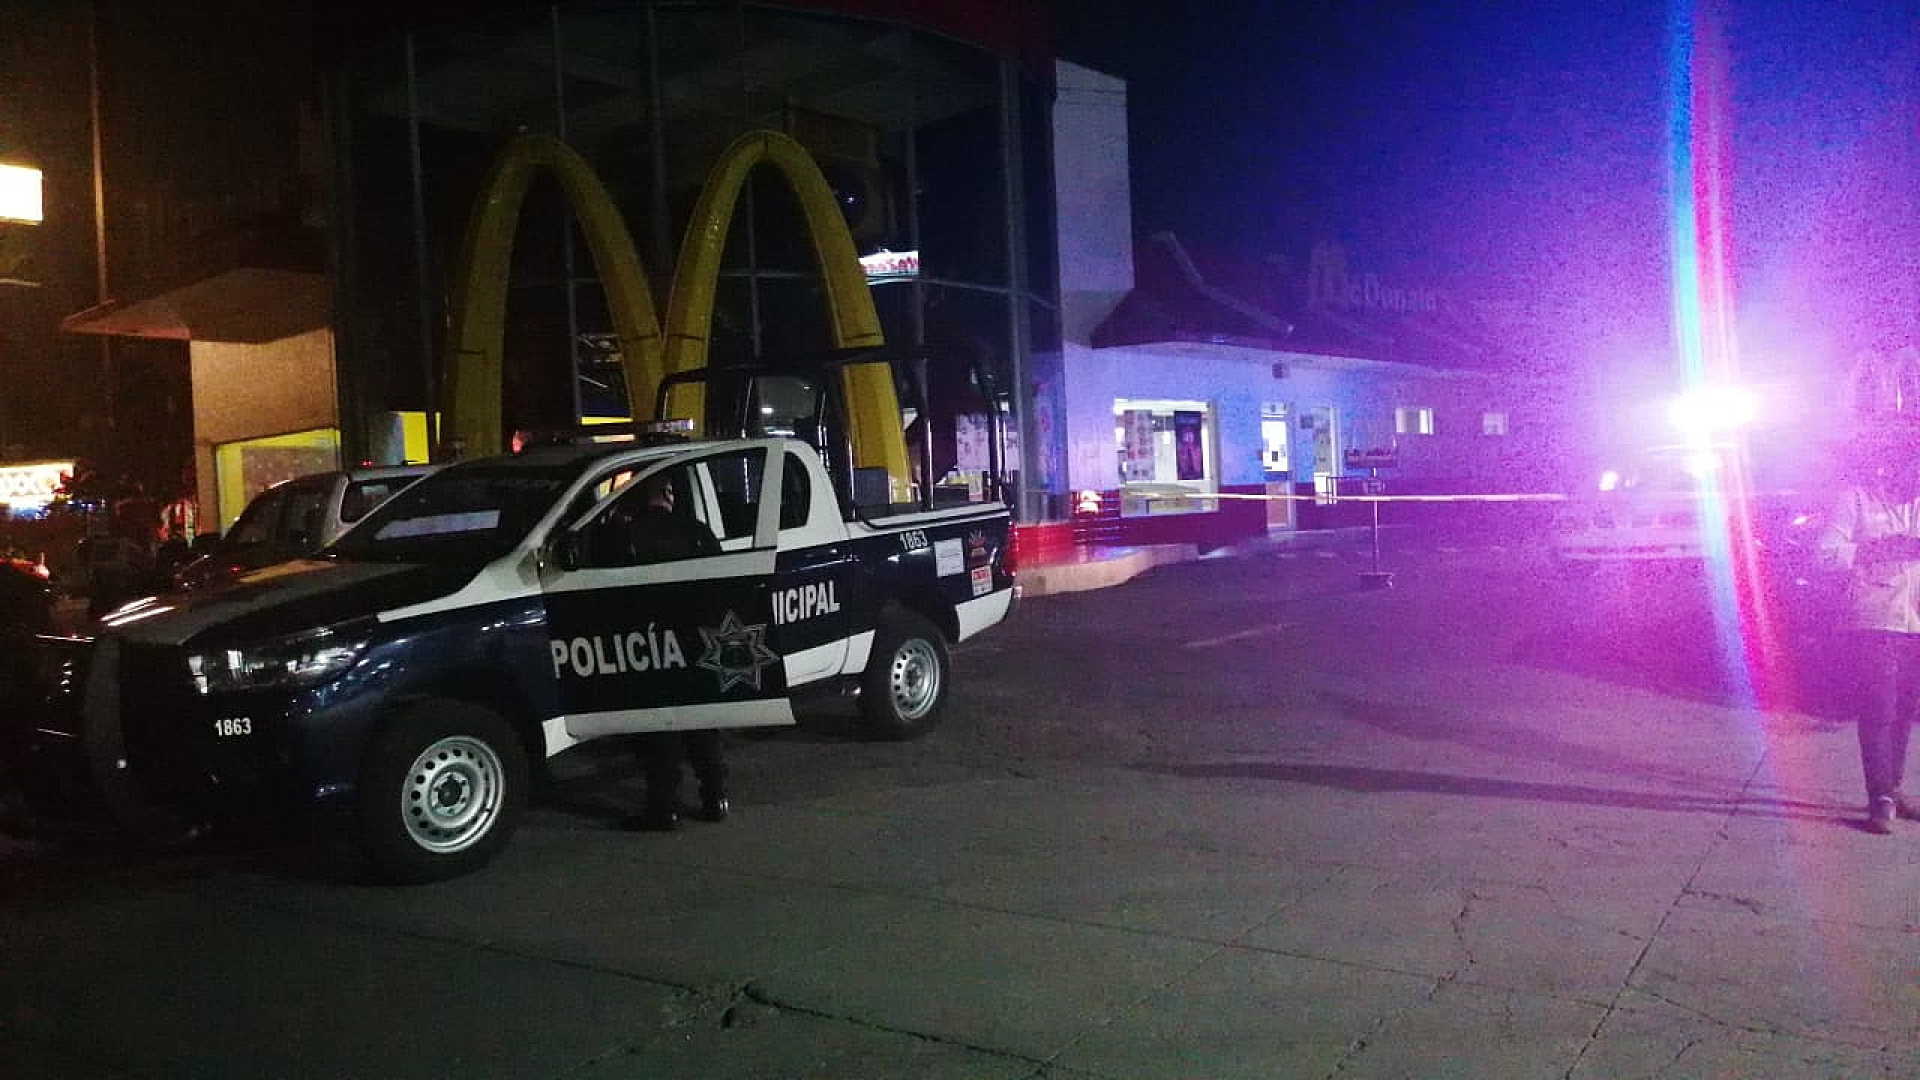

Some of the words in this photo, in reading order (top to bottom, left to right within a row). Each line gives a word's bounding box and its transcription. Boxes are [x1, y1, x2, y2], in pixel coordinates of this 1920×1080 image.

[900, 530, 928, 550] 1863
[550, 622, 687, 679] POLICÍA
[771, 579, 841, 625] ICIPAL
[214, 717, 252, 737] 1863
